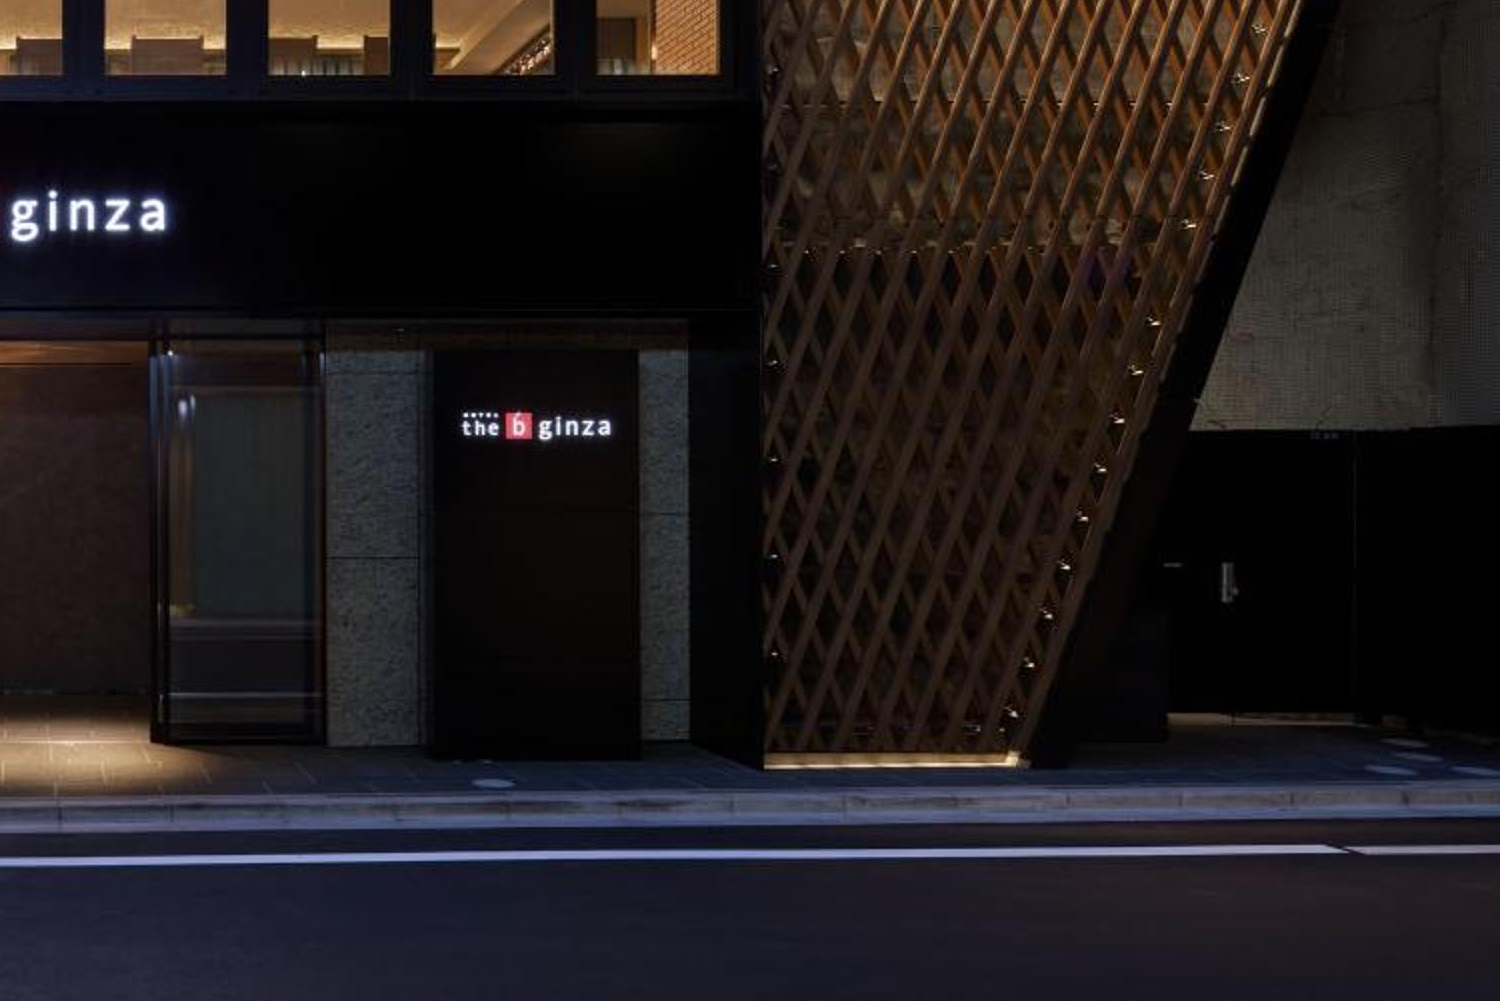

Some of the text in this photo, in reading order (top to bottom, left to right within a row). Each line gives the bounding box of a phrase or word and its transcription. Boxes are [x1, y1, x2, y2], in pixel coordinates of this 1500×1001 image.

[10, 190, 167, 242] ginza
[461, 420, 499, 436] the
[538, 416, 612, 441] ginza
